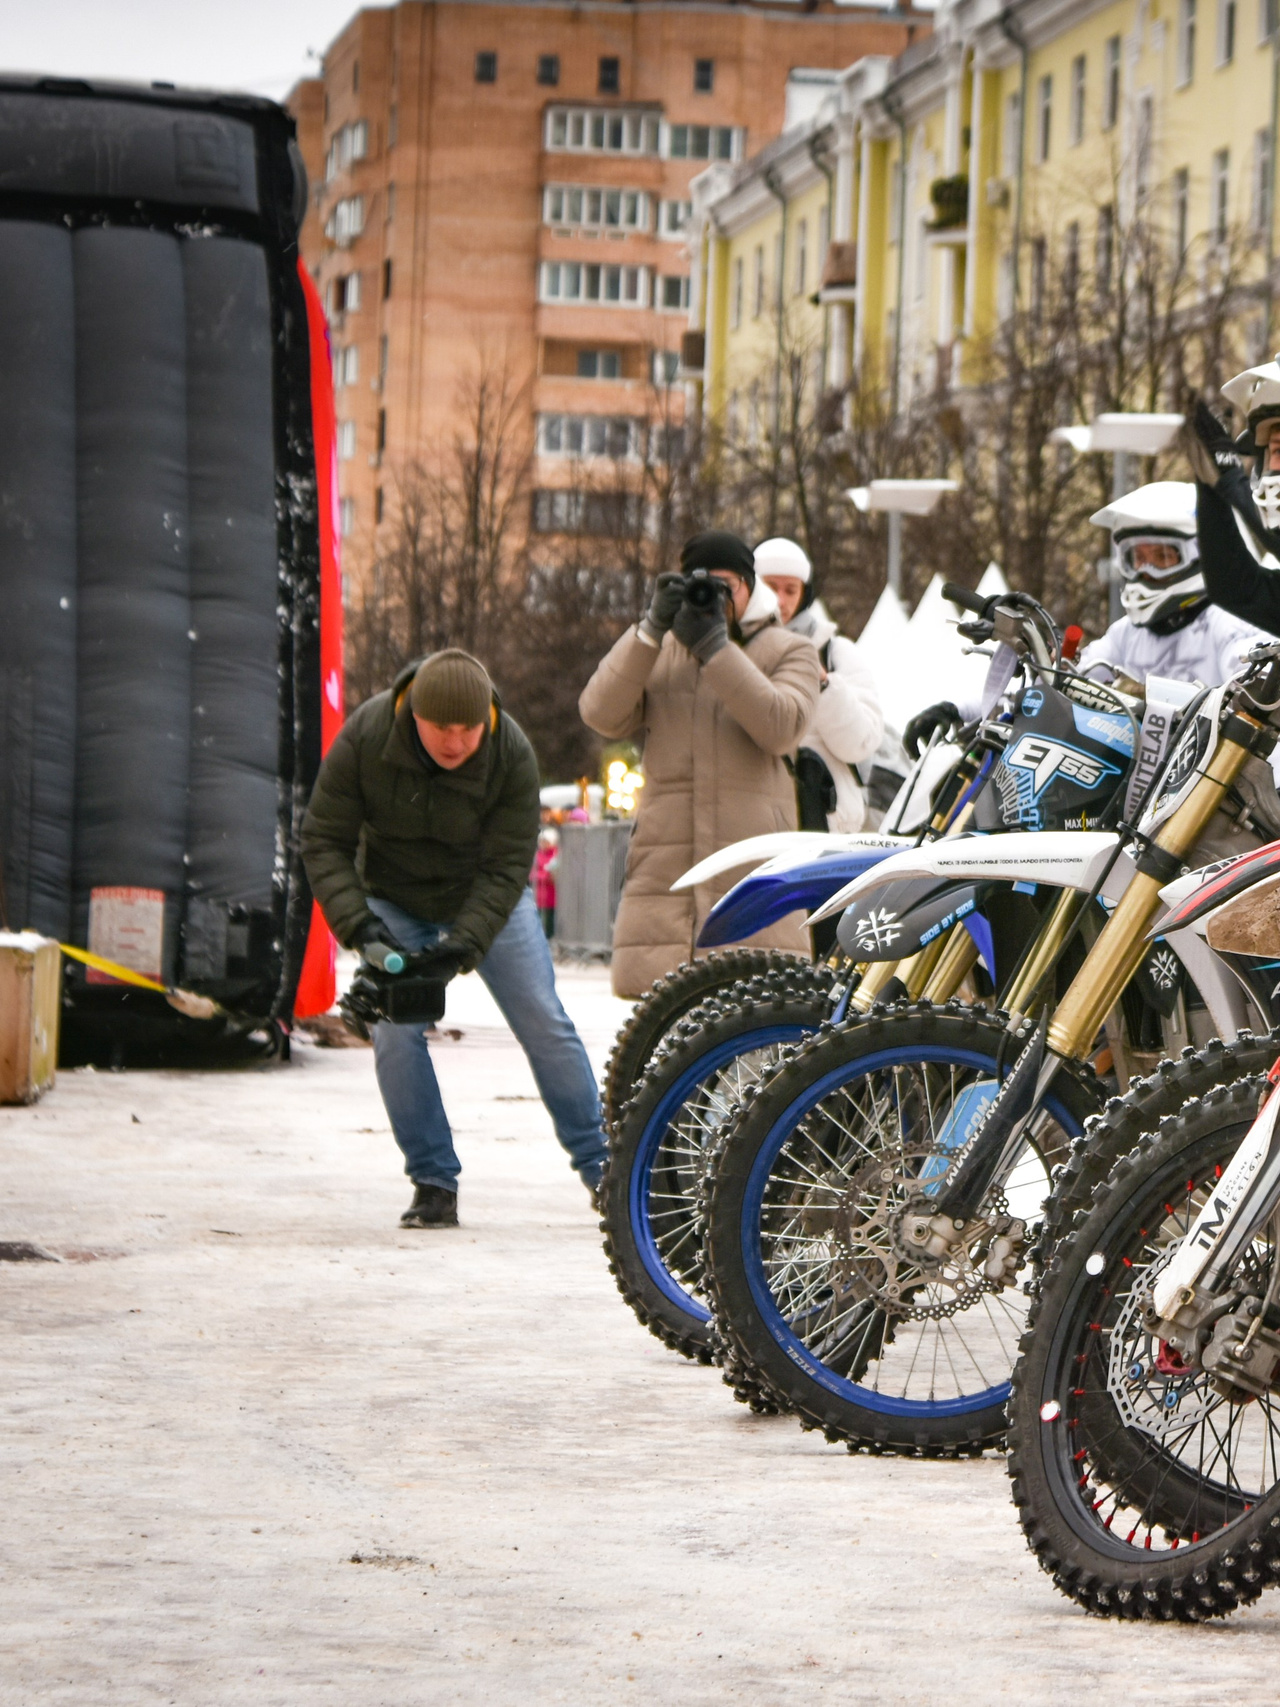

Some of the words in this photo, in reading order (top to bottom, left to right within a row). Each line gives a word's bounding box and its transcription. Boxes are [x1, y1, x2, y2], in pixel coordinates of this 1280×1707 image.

[1008, 736, 1105, 797] ET55
[1129, 713, 1167, 816] WHITELAB
[919, 925, 941, 947] SIDE
[941, 913, 955, 929] BY
[955, 899, 975, 918] SIDE
[786, 1345, 817, 1377] EXCEL
